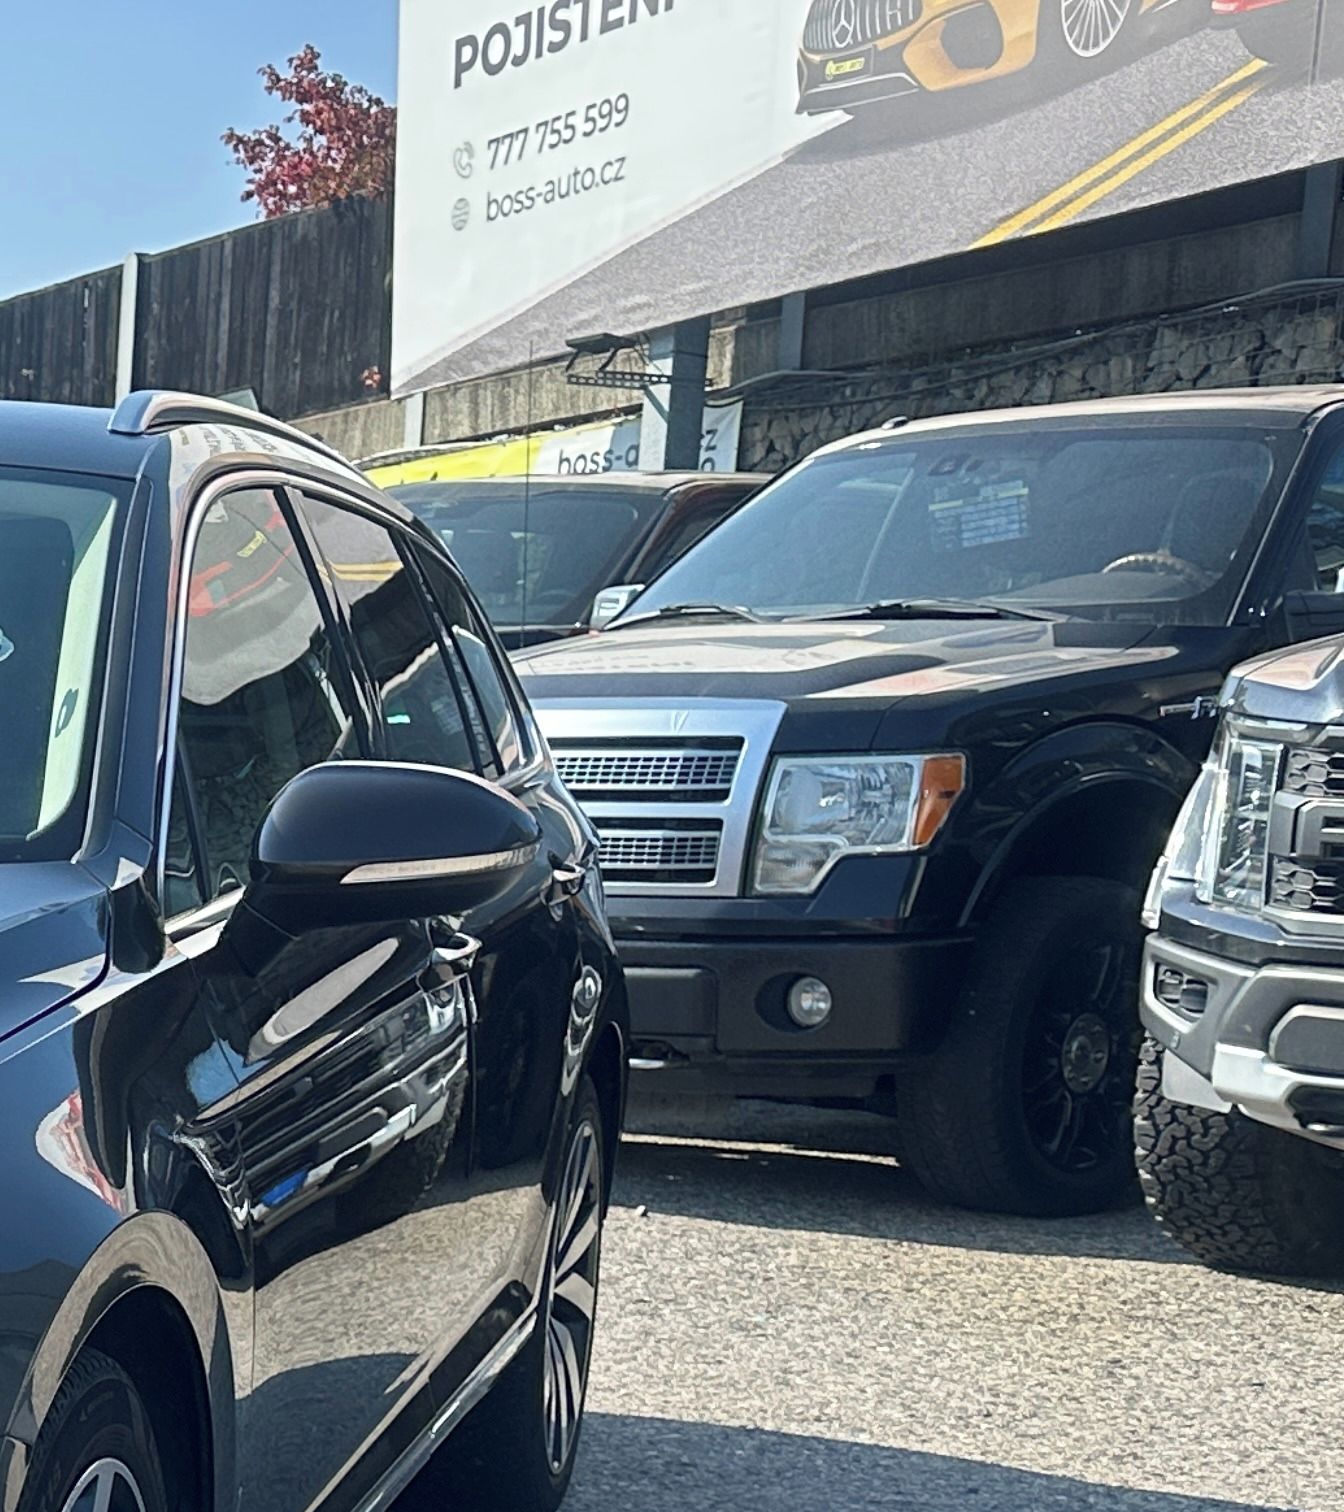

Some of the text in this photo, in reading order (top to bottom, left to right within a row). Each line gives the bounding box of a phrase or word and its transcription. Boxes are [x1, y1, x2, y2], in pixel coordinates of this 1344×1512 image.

[486, 92, 630, 170] 777 755 599
[486, 156, 627, 222] boss-auto.cz
